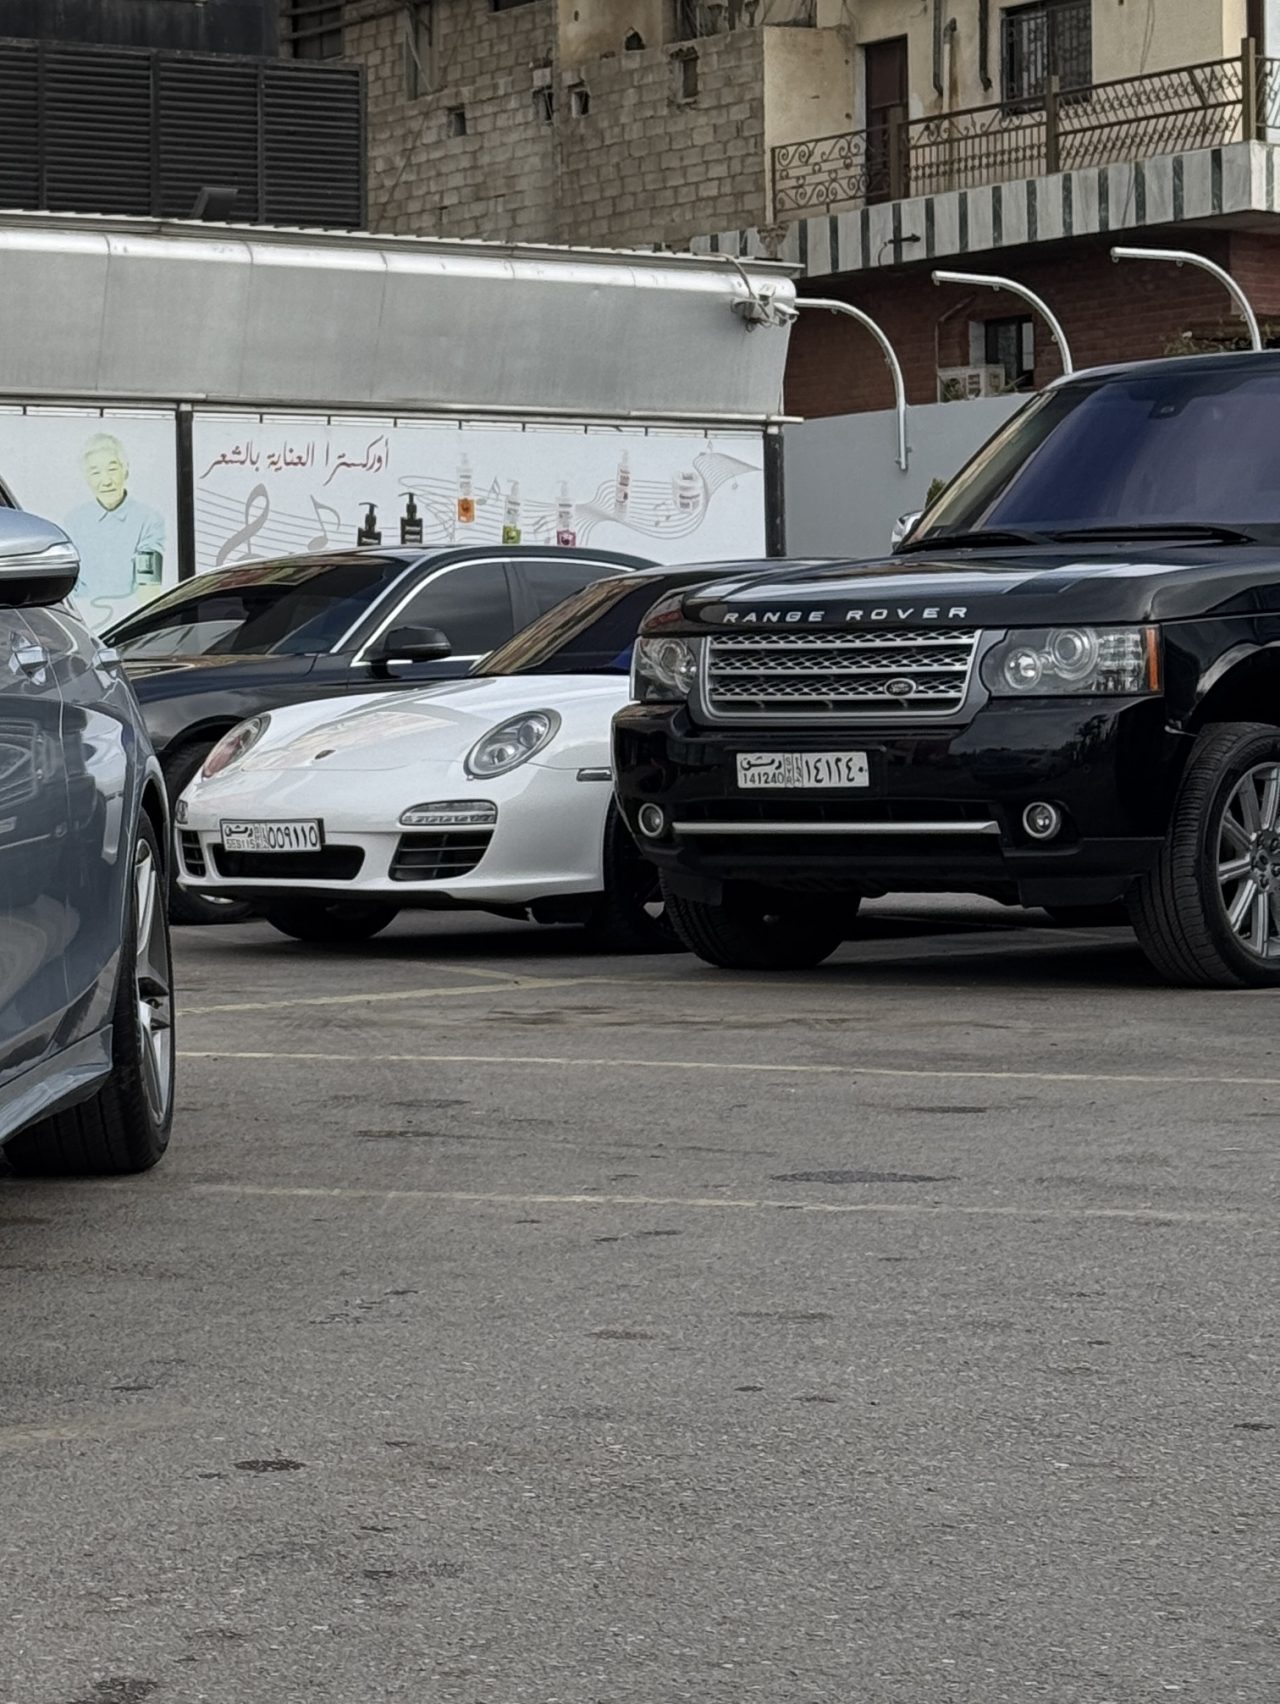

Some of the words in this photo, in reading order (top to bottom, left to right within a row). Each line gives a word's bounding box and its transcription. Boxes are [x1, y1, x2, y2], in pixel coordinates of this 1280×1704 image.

[199, 439, 261, 479] بالشعر
[267, 440, 315, 472] العناية
[723, 611, 825, 623] RANGE
[846, 607, 968, 621] ROVER
[743, 771, 784, 784] 141240
